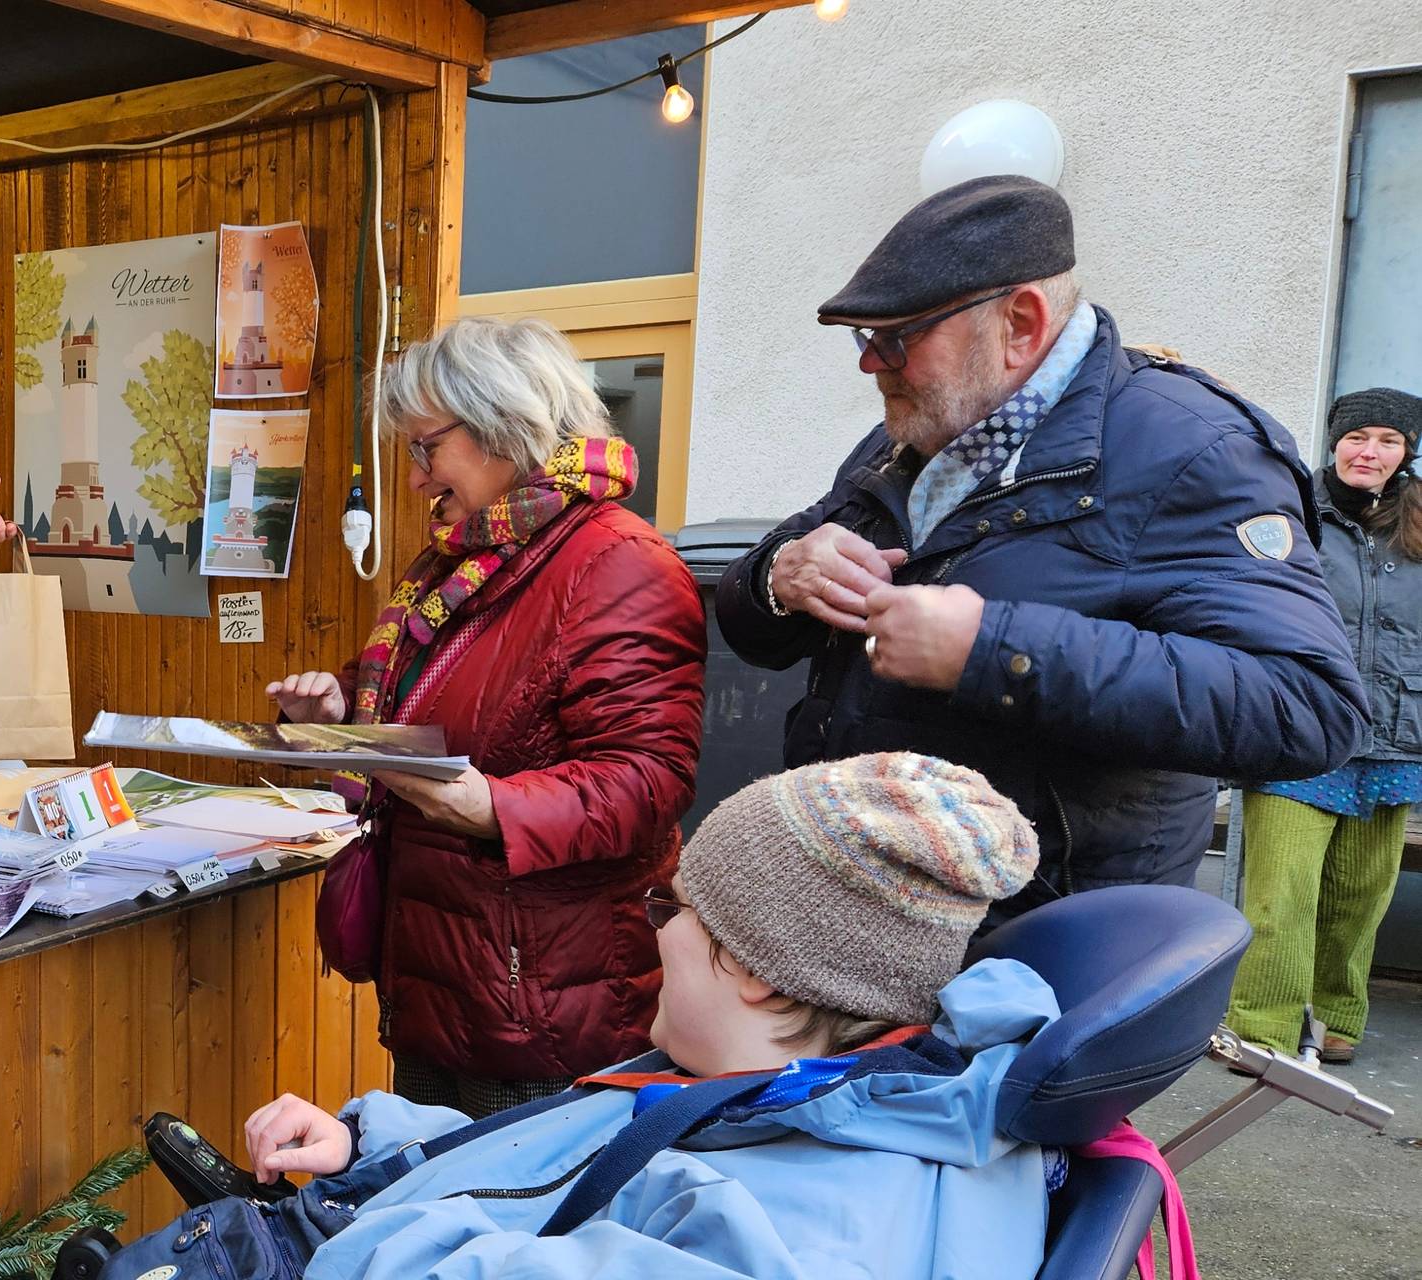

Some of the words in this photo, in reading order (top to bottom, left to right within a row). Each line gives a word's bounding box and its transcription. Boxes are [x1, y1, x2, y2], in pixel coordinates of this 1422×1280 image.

[111, 268, 194, 299] Wetter
[128, 300, 138, 308] AN
[140, 299, 154, 307] DER
[156, 297, 176, 305] RUHR
[220, 596, 258, 609] Poster
